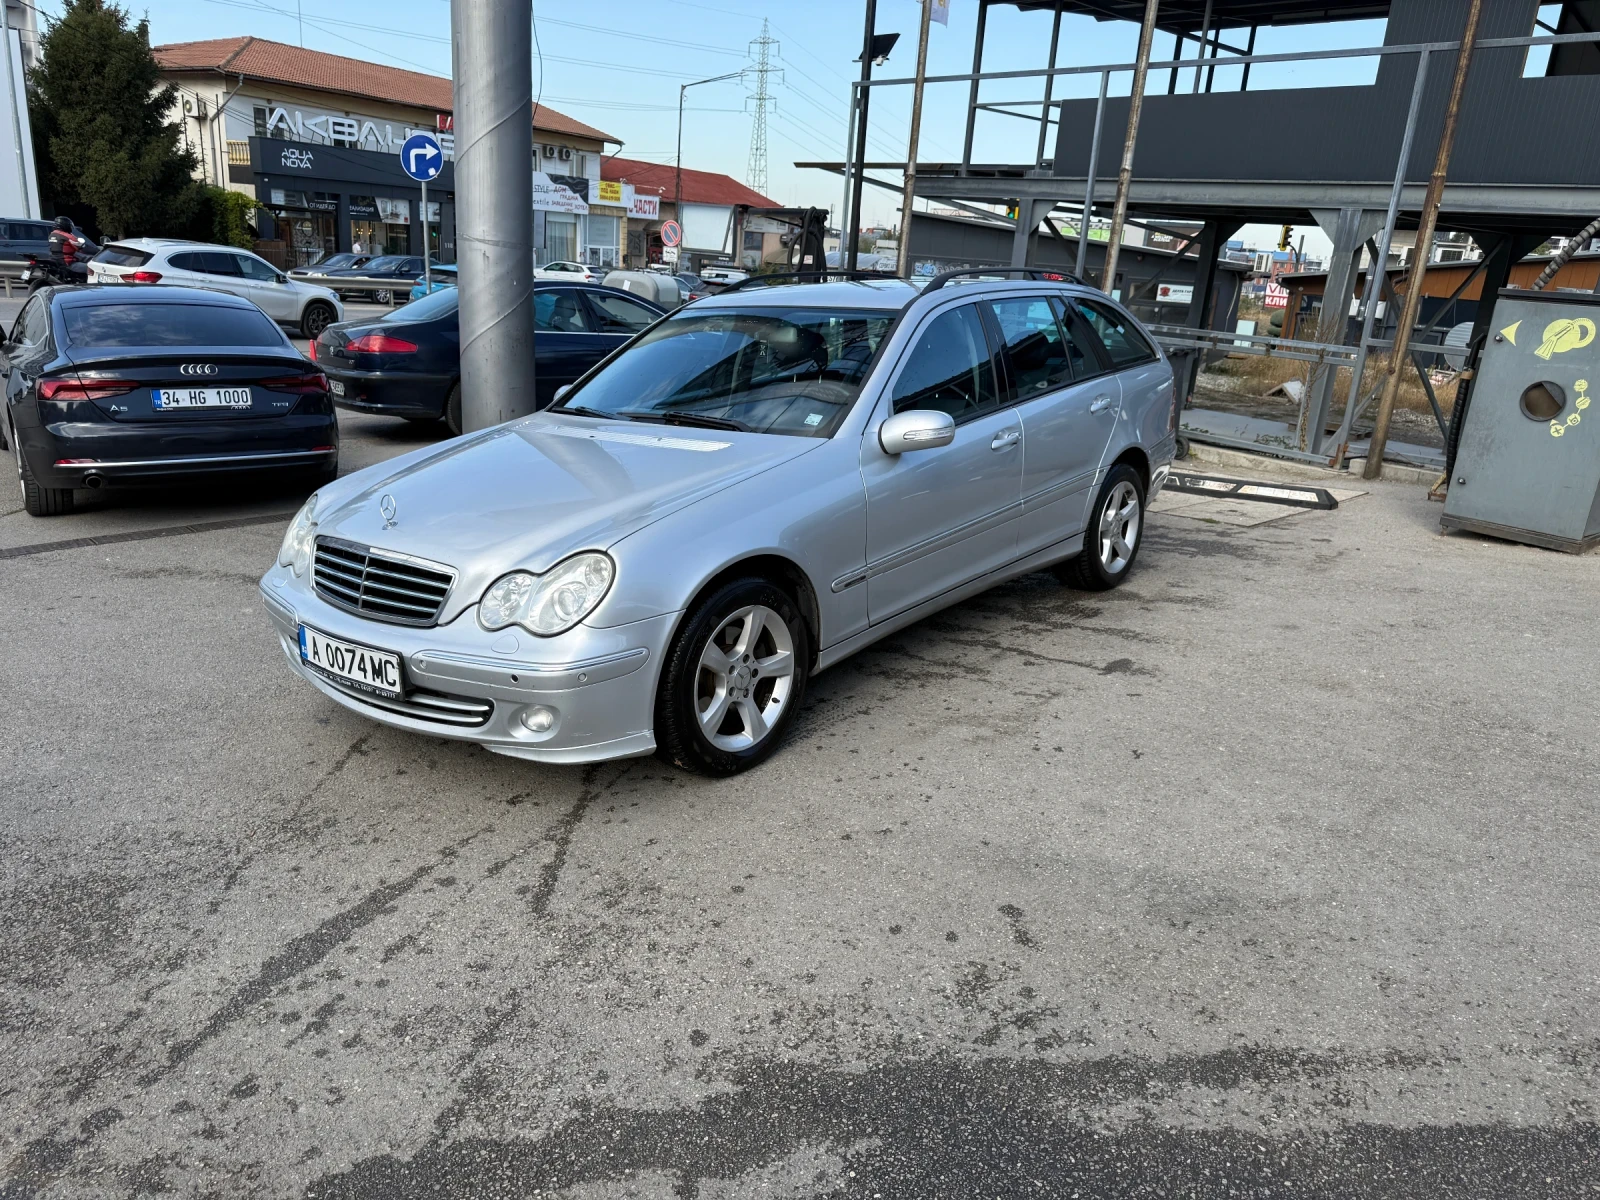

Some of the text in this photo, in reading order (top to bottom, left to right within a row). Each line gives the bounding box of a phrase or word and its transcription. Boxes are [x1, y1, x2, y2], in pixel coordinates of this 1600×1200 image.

[281, 148, 314, 160] AQUA
[281, 157, 312, 169] NOVA
[1265, 295, 1288, 307] КЛИ
[162, 391, 180, 405] 34
[189, 390, 207, 405] HG
[216, 389, 249, 404] 1000
[109, 404, 128, 412] A5
[312, 635, 321, 663] A
